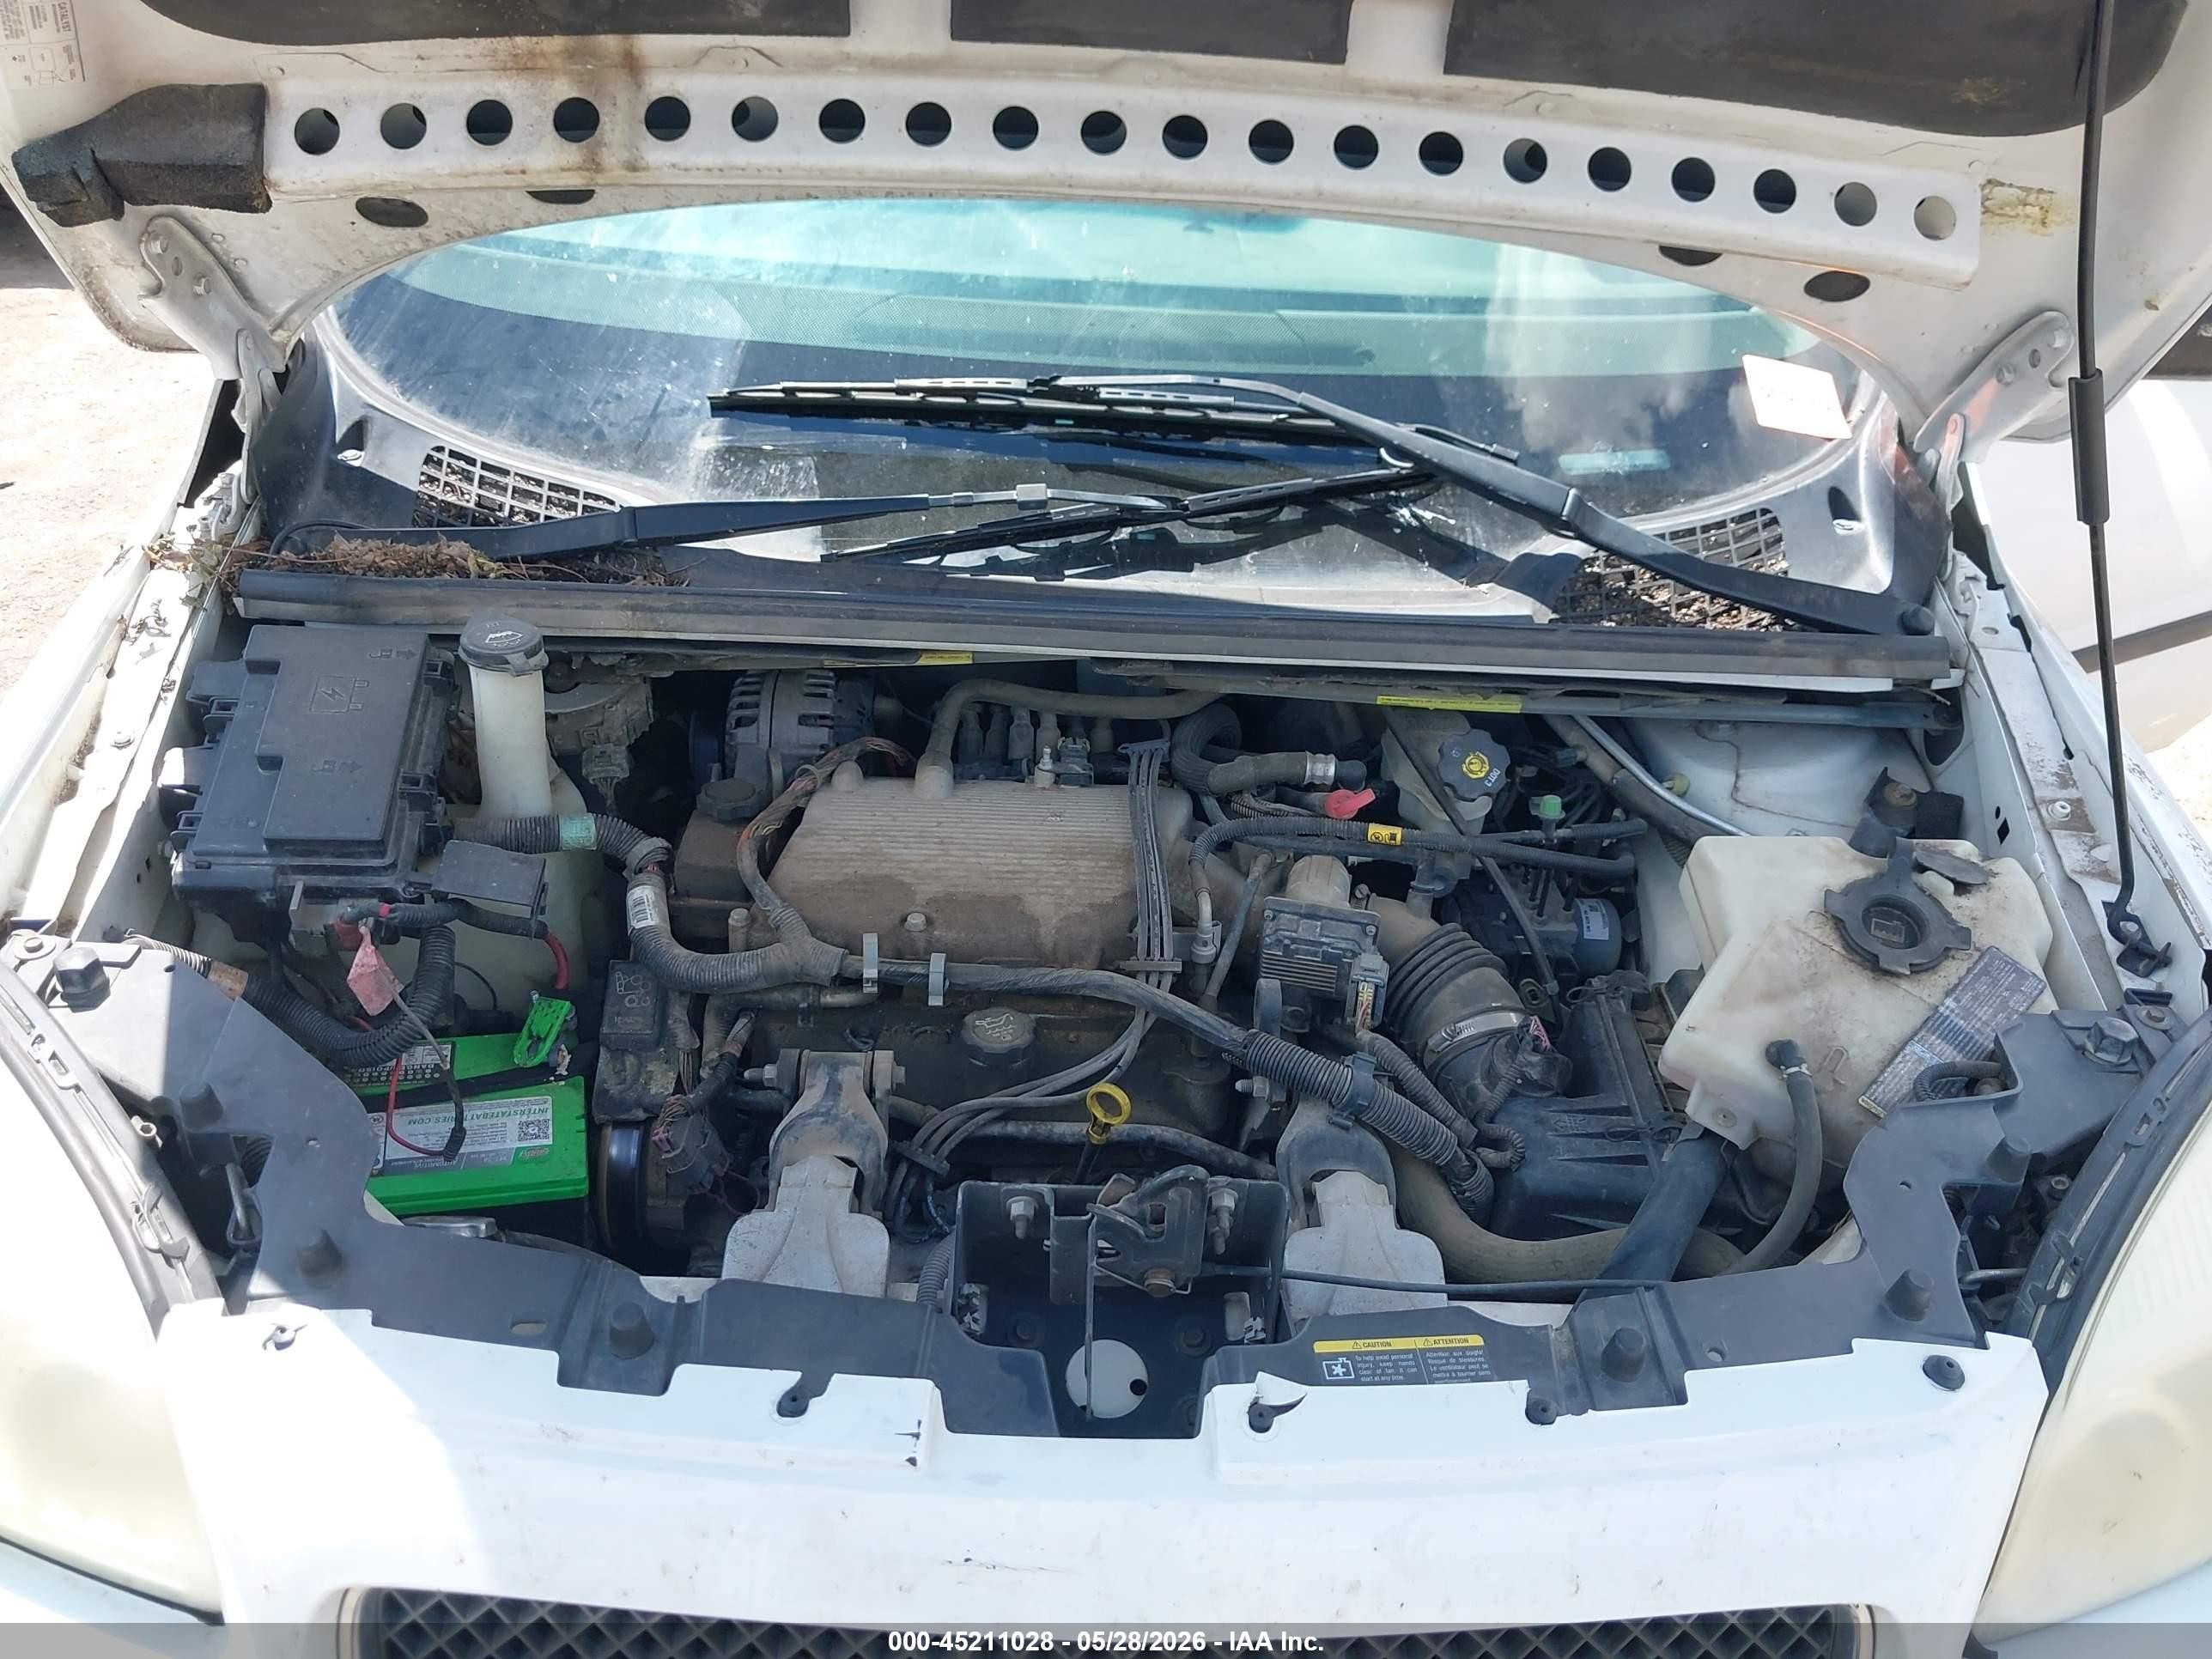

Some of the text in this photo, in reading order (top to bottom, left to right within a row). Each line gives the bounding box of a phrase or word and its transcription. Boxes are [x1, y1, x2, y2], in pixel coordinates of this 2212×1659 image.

[58, 2, 71, 32] CATALYST
[408, 1107, 549, 1126] INTERSTATEBATTRIES.COM
[1433, 1337, 1469, 1346] ATTENTION
